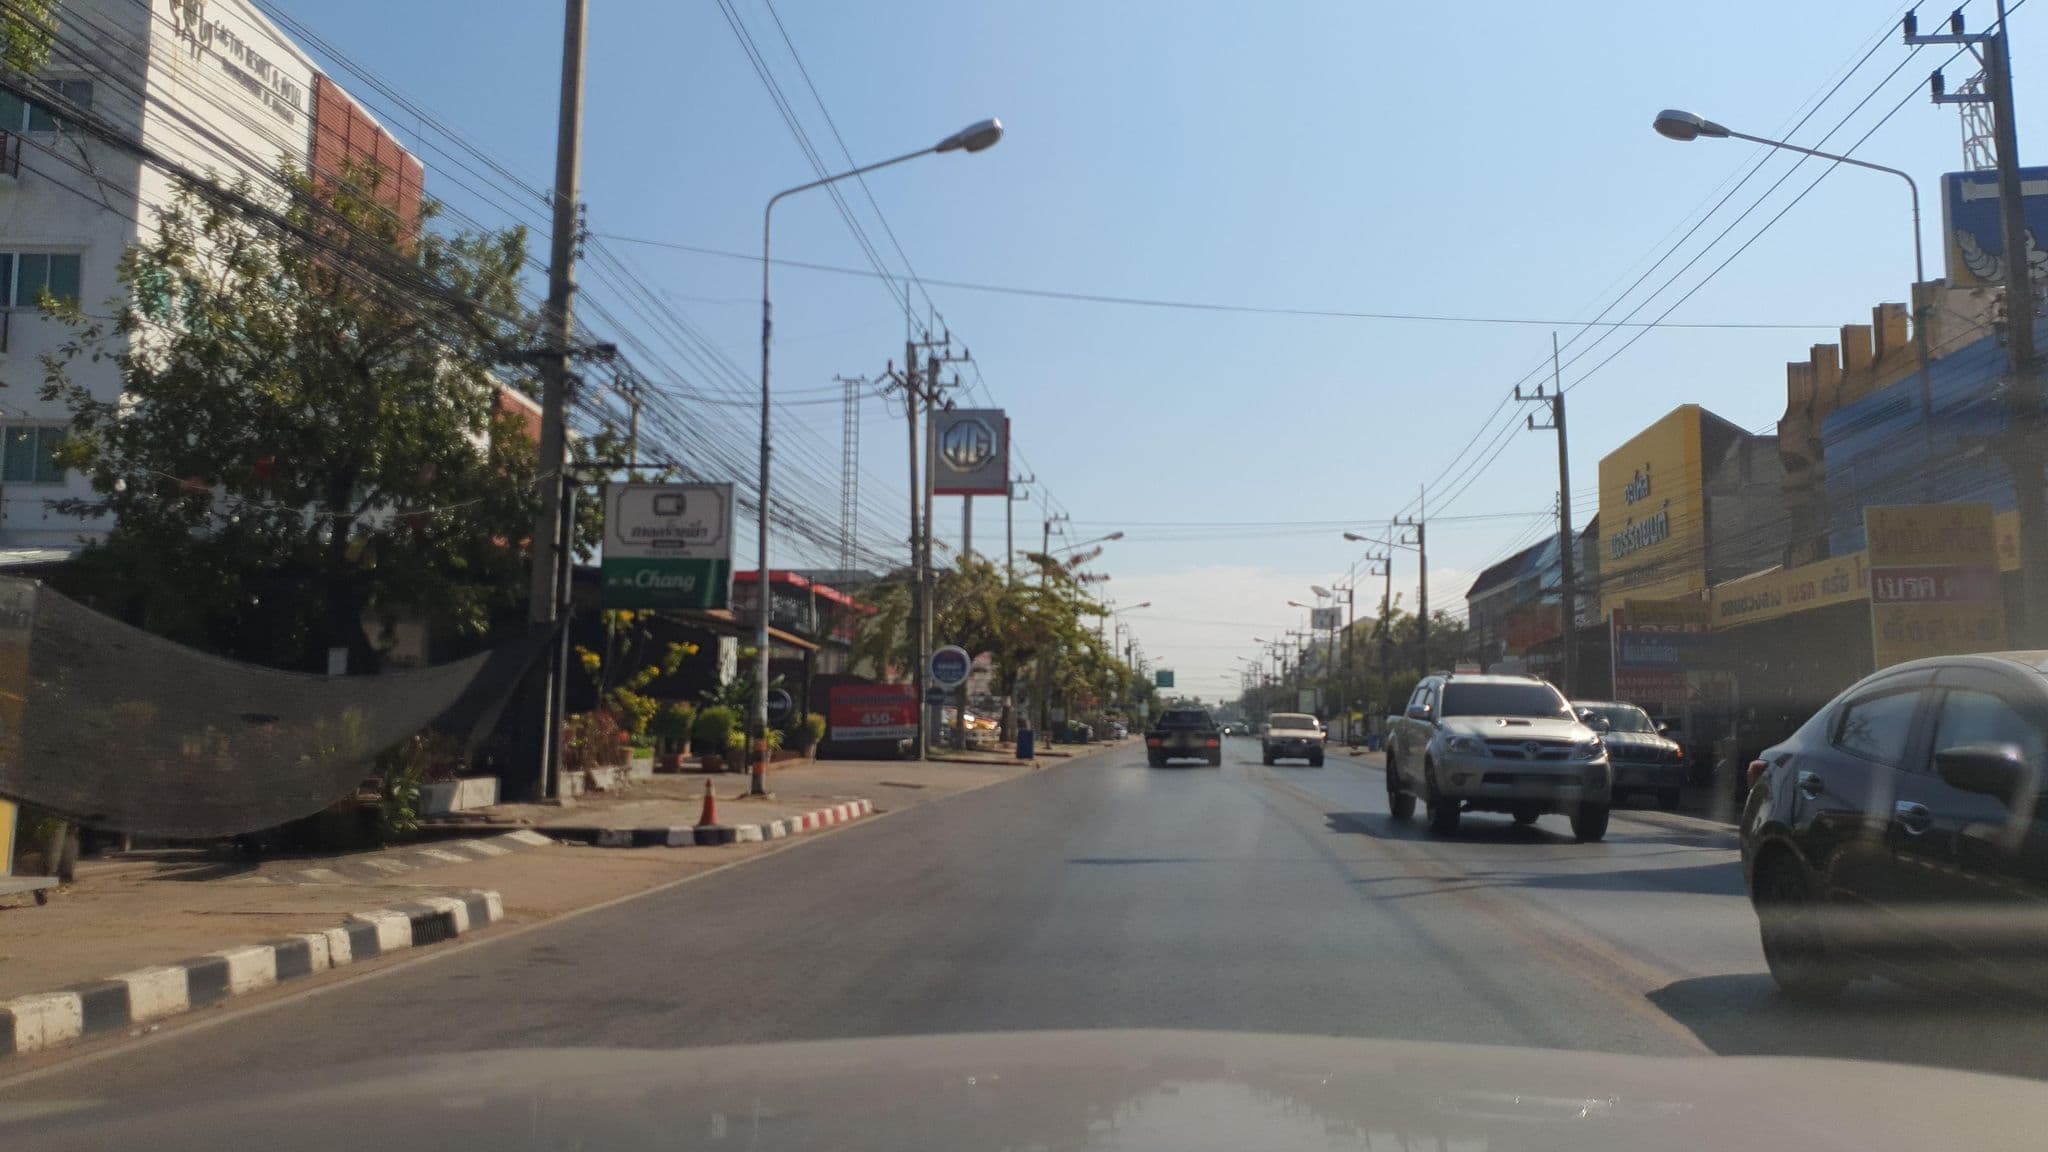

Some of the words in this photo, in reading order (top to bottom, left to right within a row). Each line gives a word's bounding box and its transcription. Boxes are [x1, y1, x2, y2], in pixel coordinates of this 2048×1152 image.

[214, 19, 243, 61] CACTUS
[245, 45, 270, 83] RESORT
[280, 76, 301, 108] HOTEL
[944, 421, 990, 465] MG
[635, 569, 695, 592] Chang
